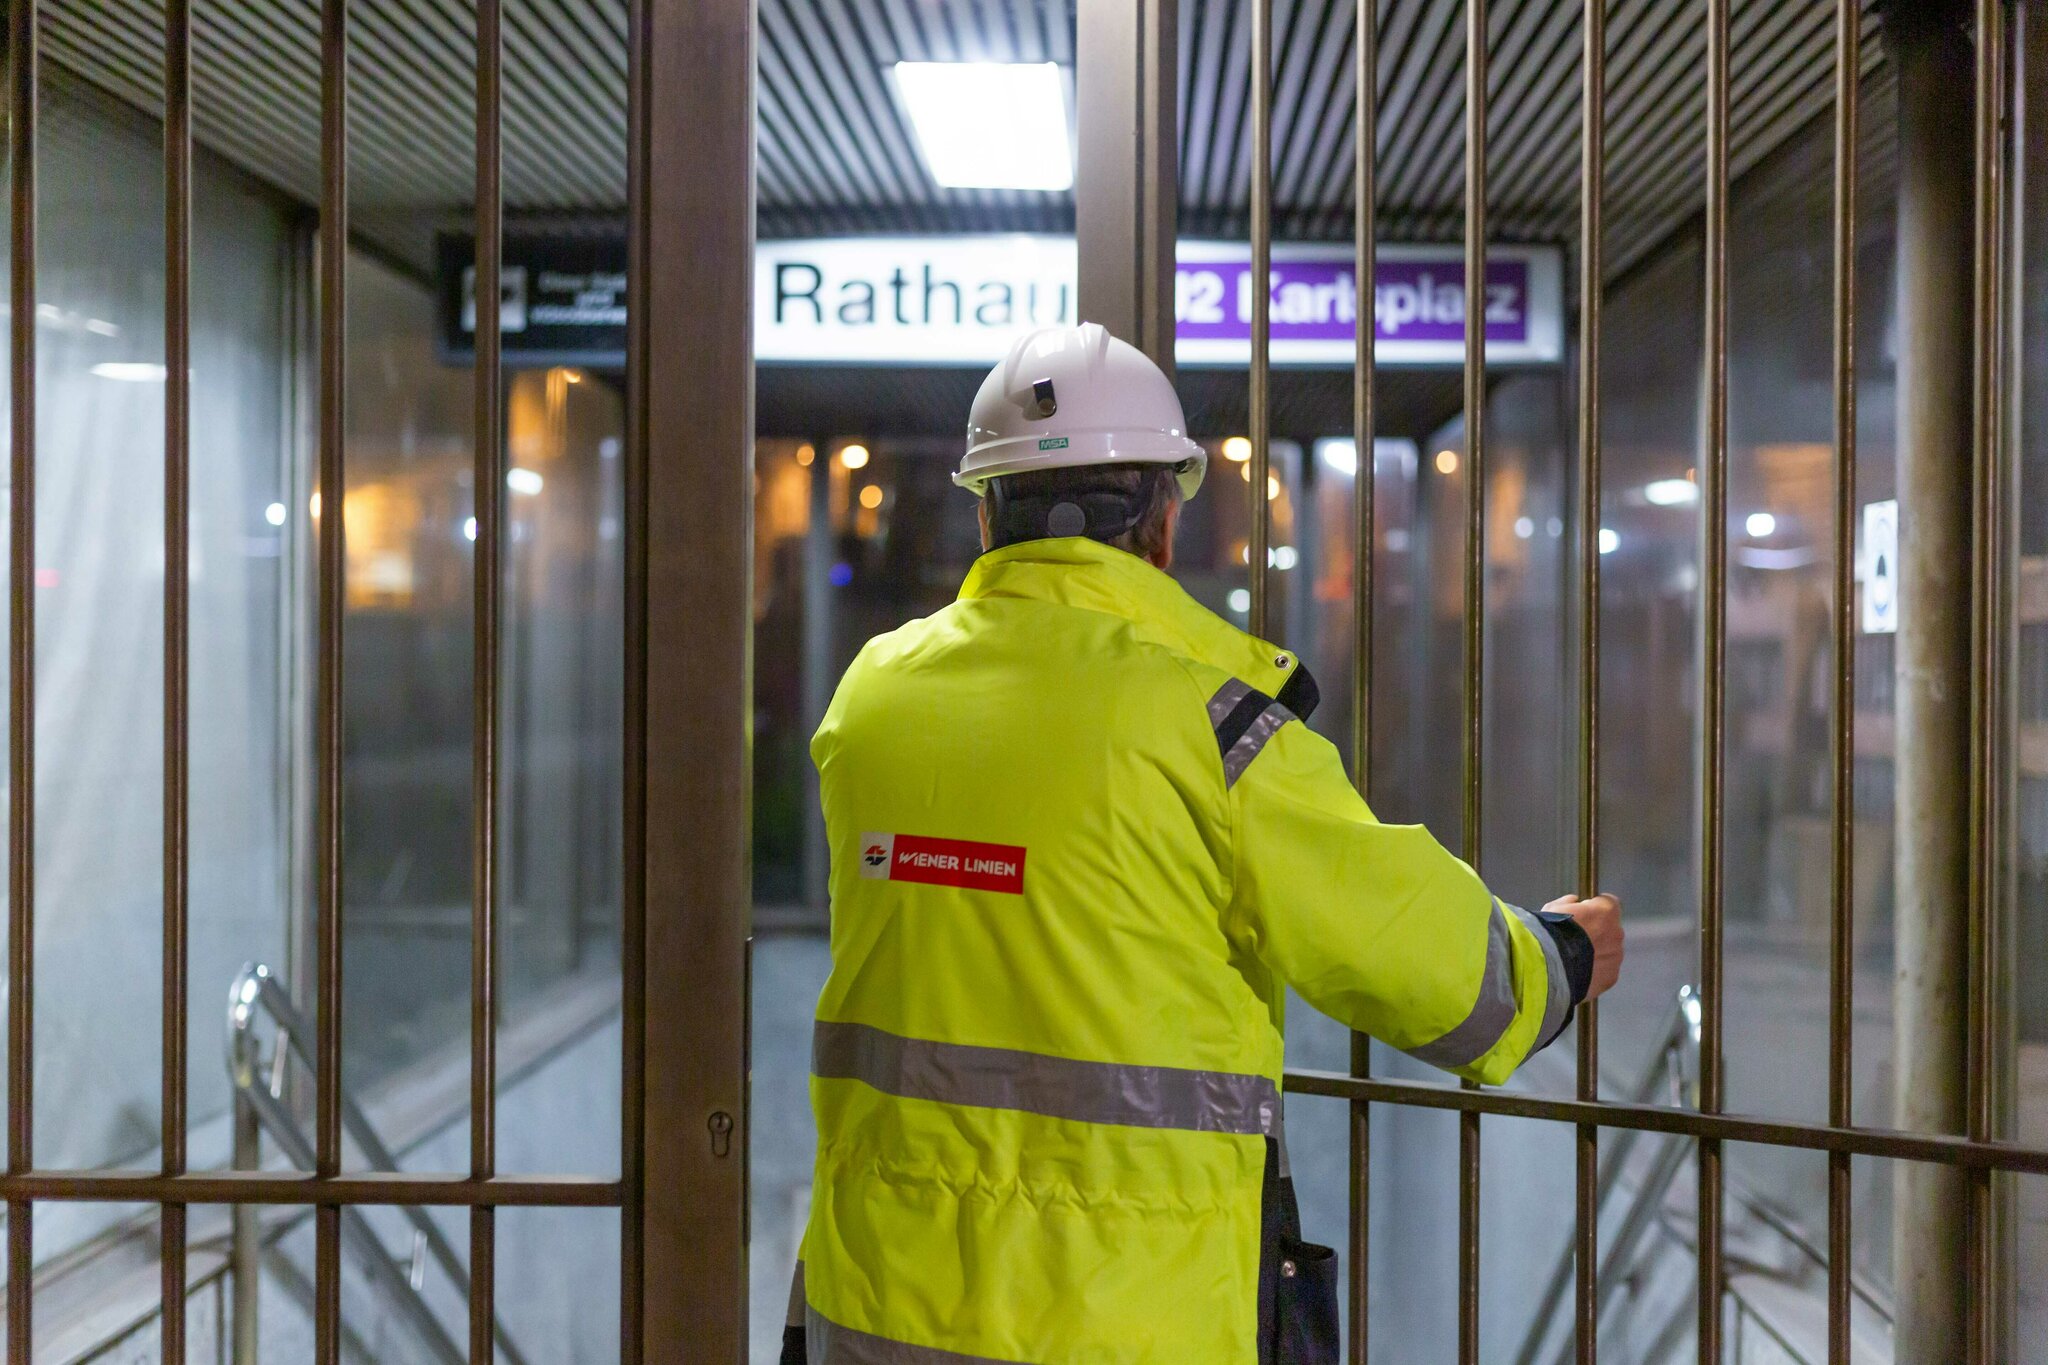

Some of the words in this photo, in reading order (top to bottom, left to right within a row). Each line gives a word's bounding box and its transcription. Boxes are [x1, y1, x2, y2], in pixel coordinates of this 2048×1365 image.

[774, 262, 1068, 326] Rathau
[1040, 439, 1068, 450] MSA
[898, 851, 959, 870] WIENER
[964, 858, 1017, 877] LINIEN
